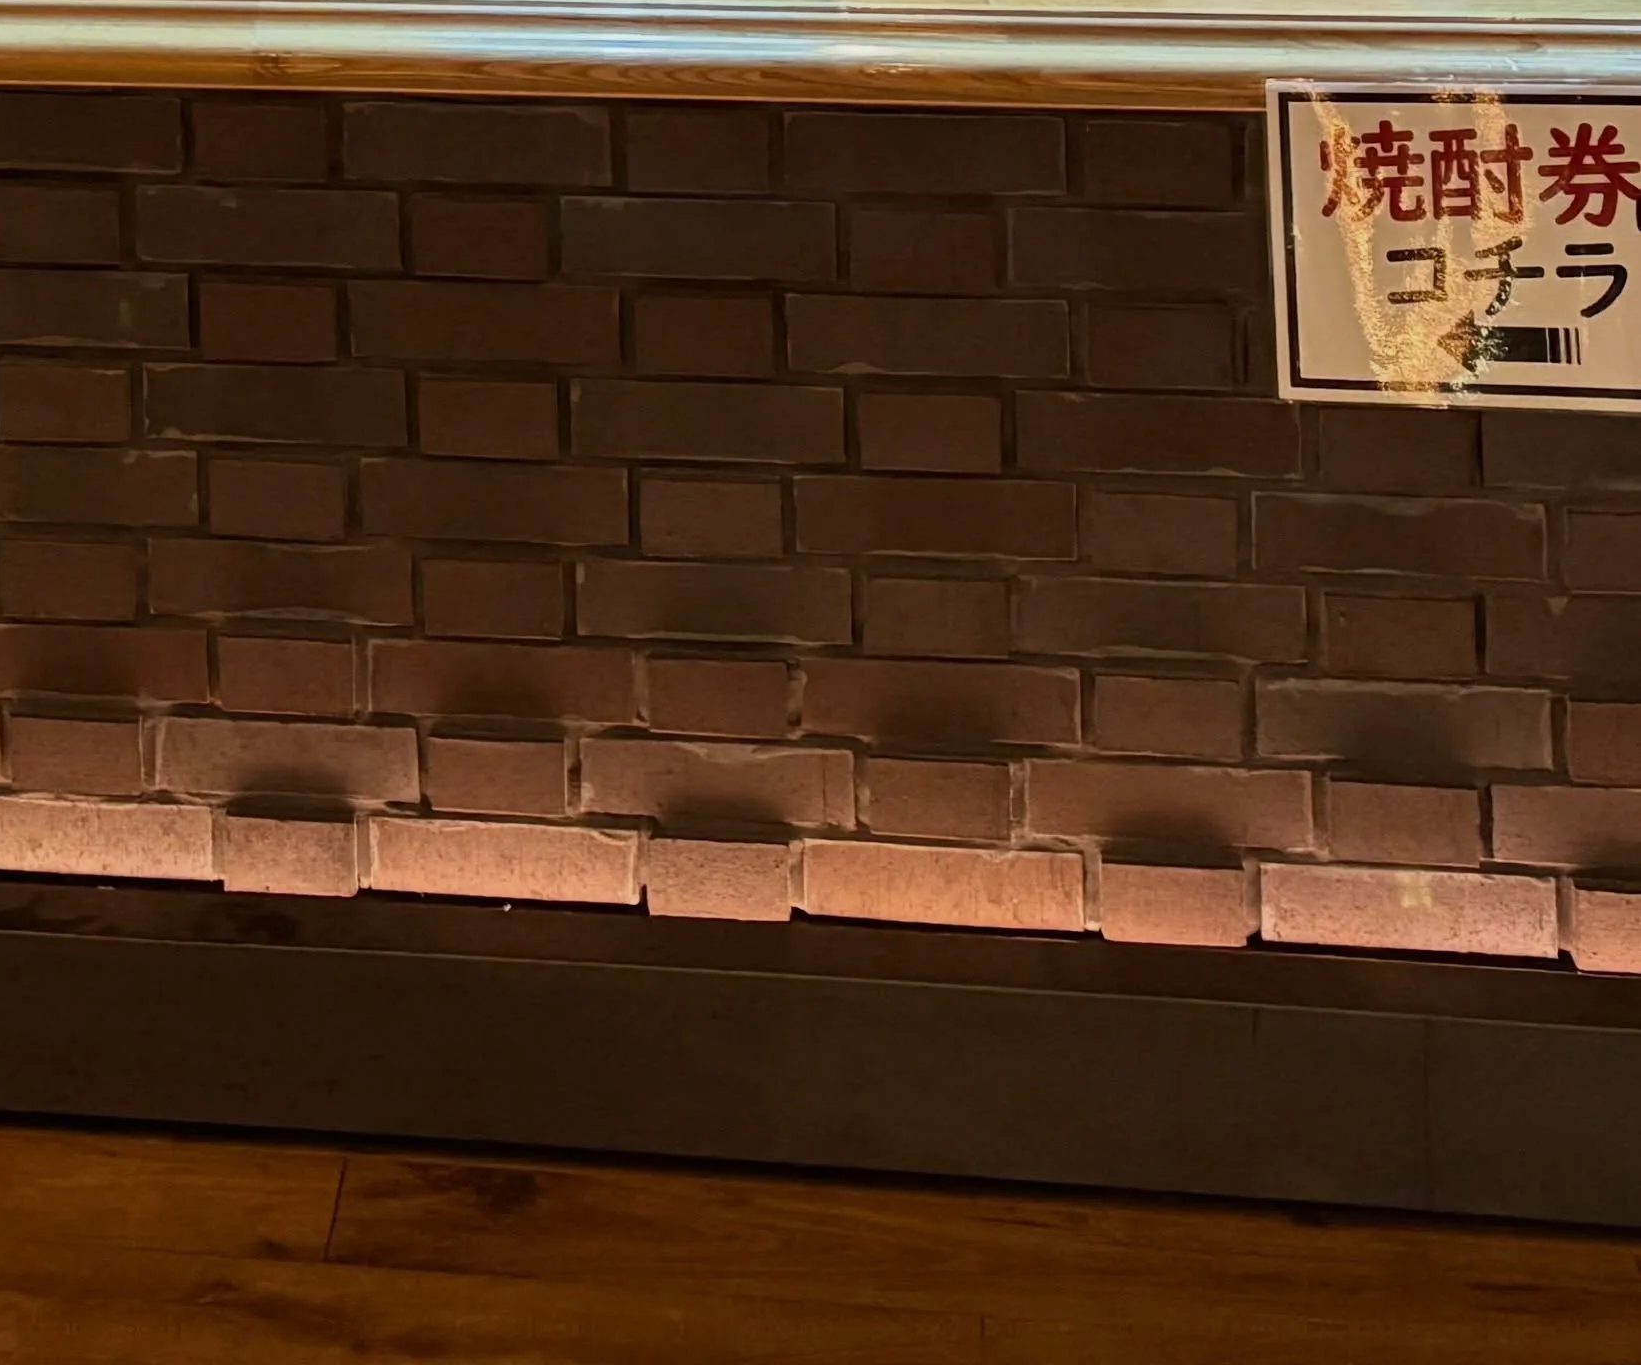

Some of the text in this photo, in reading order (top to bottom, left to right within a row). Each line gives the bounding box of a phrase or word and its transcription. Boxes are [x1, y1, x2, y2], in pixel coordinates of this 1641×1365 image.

[1319, 119, 1641, 227] 焼酎券
[1386, 235, 1627, 318] コチラ
